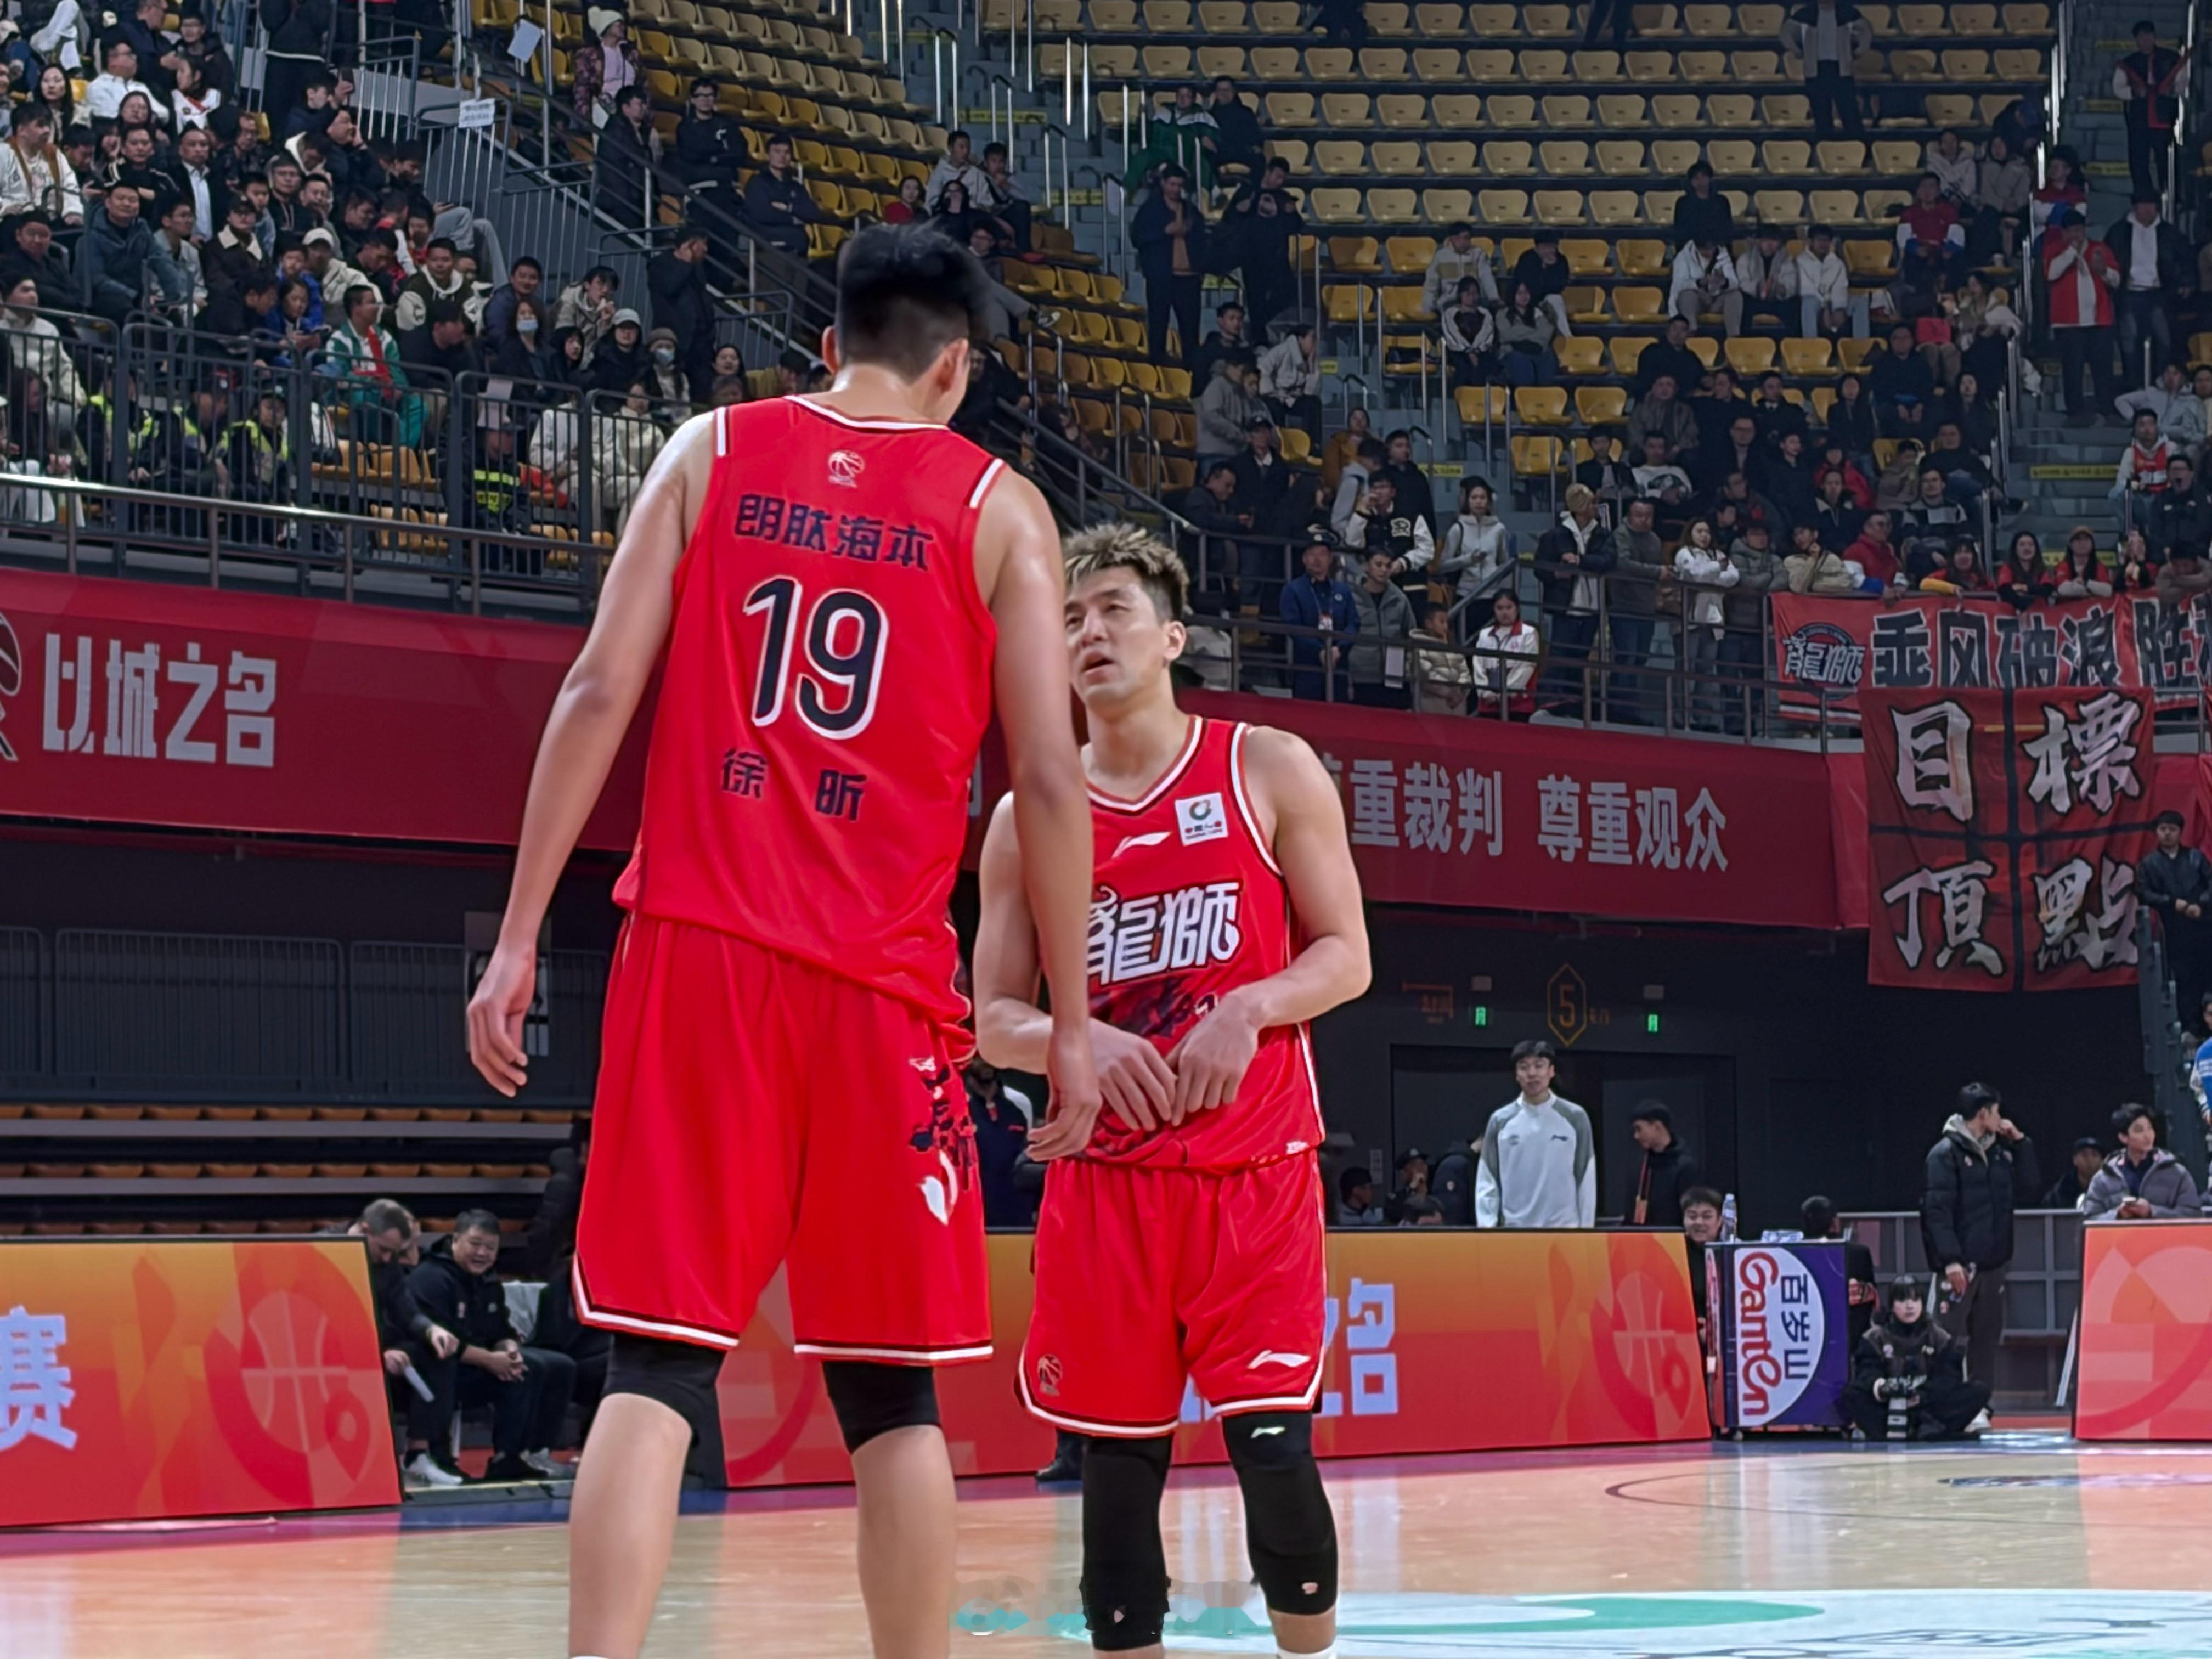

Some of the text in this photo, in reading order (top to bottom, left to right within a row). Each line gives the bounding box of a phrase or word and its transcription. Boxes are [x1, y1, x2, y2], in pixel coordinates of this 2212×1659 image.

[734, 493, 934, 571] 朗肽海本
[43, 633, 276, 768] 以城之名
[742, 574, 889, 740] 19
[721, 748, 868, 822] 徐 昕
[1890, 691, 2141, 822] 目標
[1537, 773, 1729, 872] 尊重观众
[1559, 984, 1576, 1028] 5
[0, 1305, 78, 1452] 赛
[1780, 1273, 1810, 1380] 百岁山
